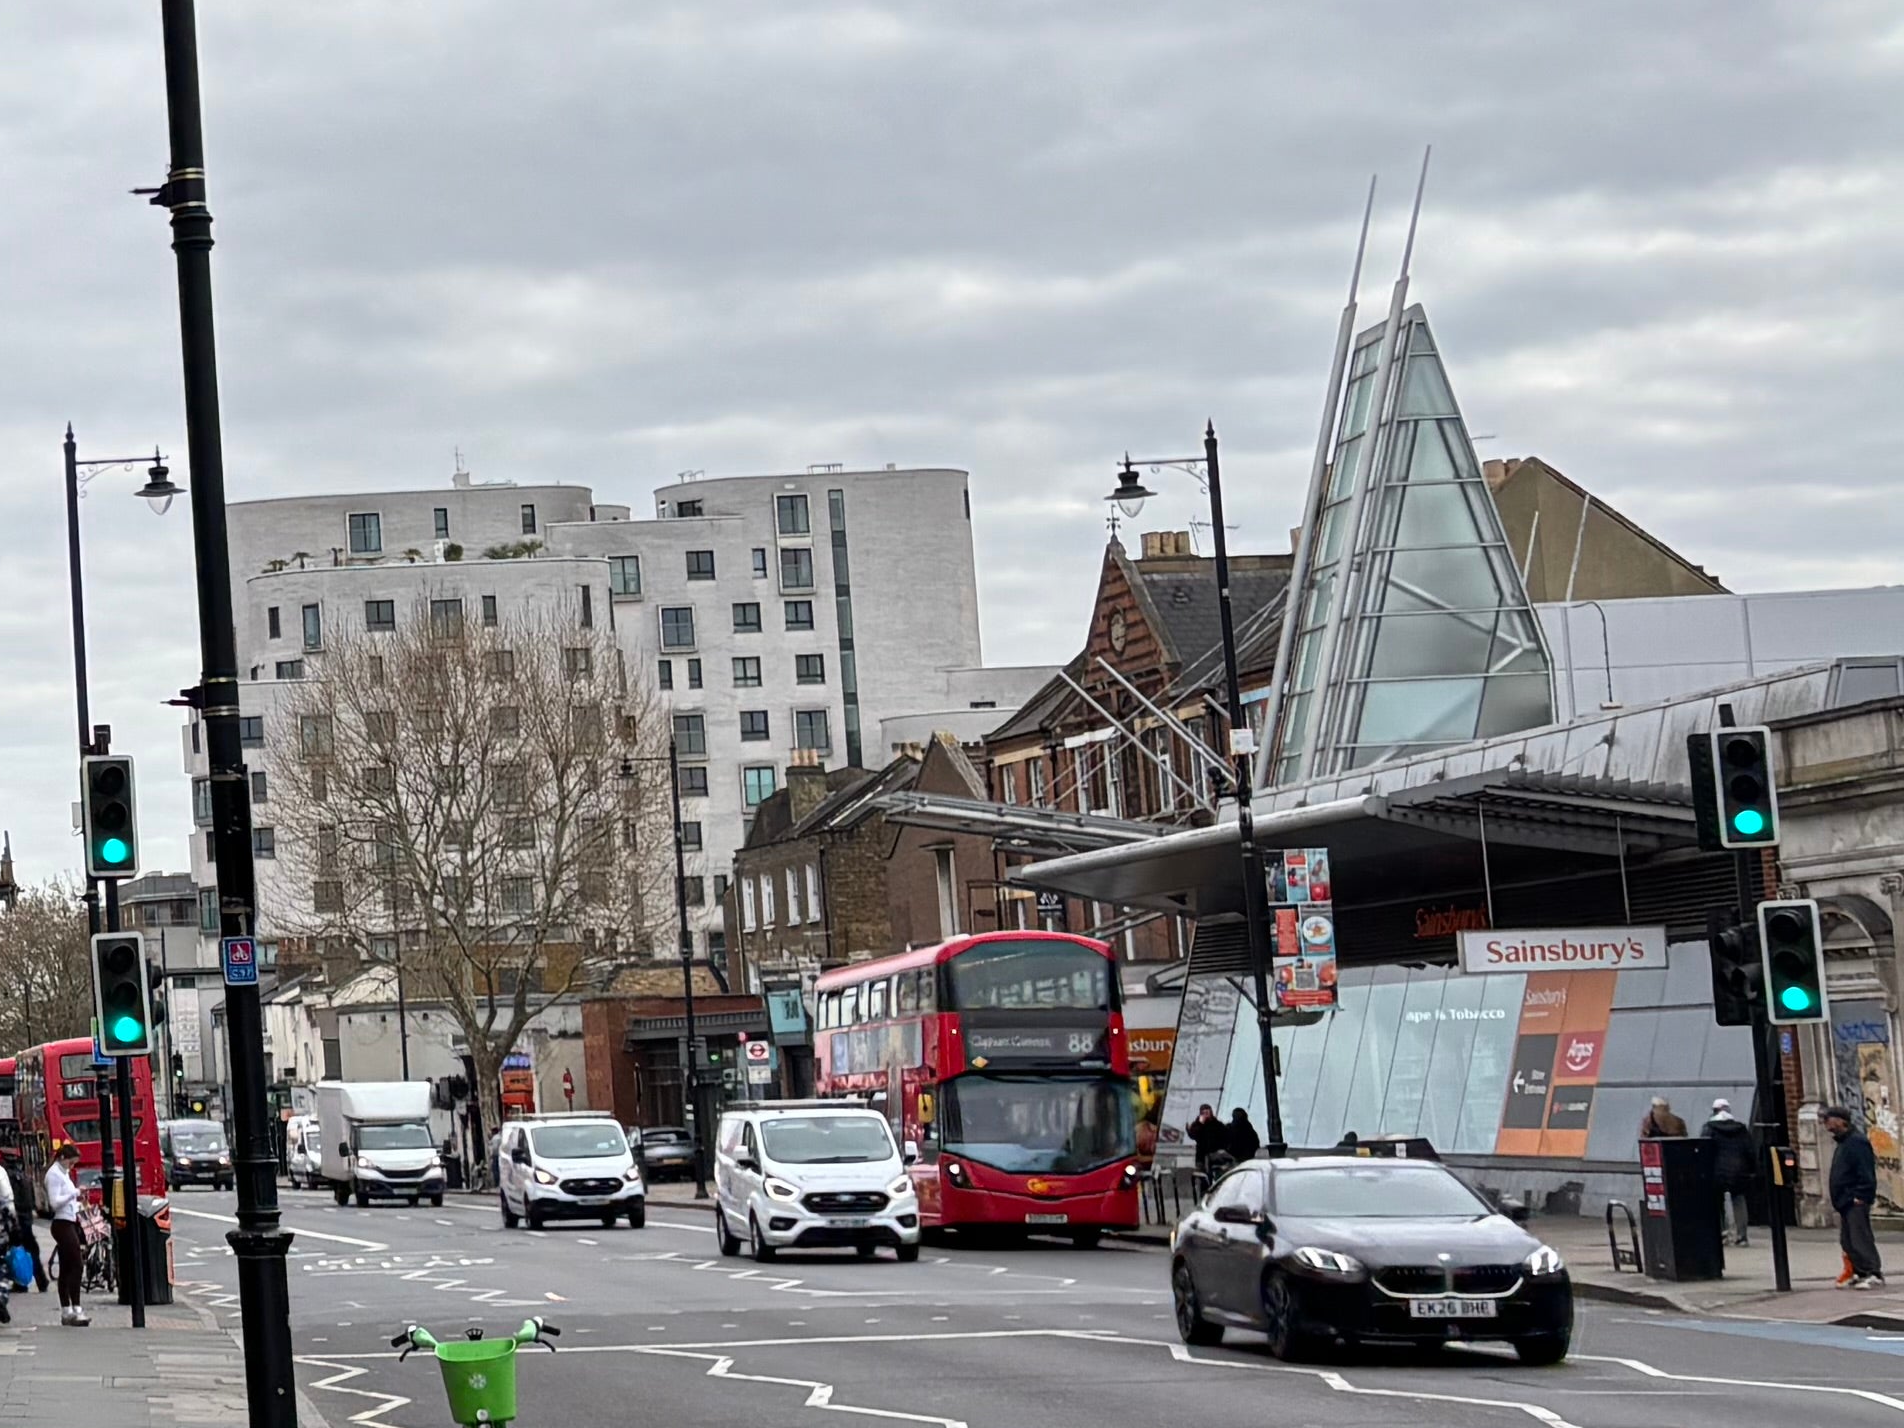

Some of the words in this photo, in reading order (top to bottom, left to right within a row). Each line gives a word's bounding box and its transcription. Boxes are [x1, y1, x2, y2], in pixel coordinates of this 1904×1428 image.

[1413, 901, 1487, 939] Sainsbury's
[1486, 937, 1645, 965] Sainsbury's
[1405, 1009, 1432, 1023] ape
[1068, 1033, 1093, 1053] 88
